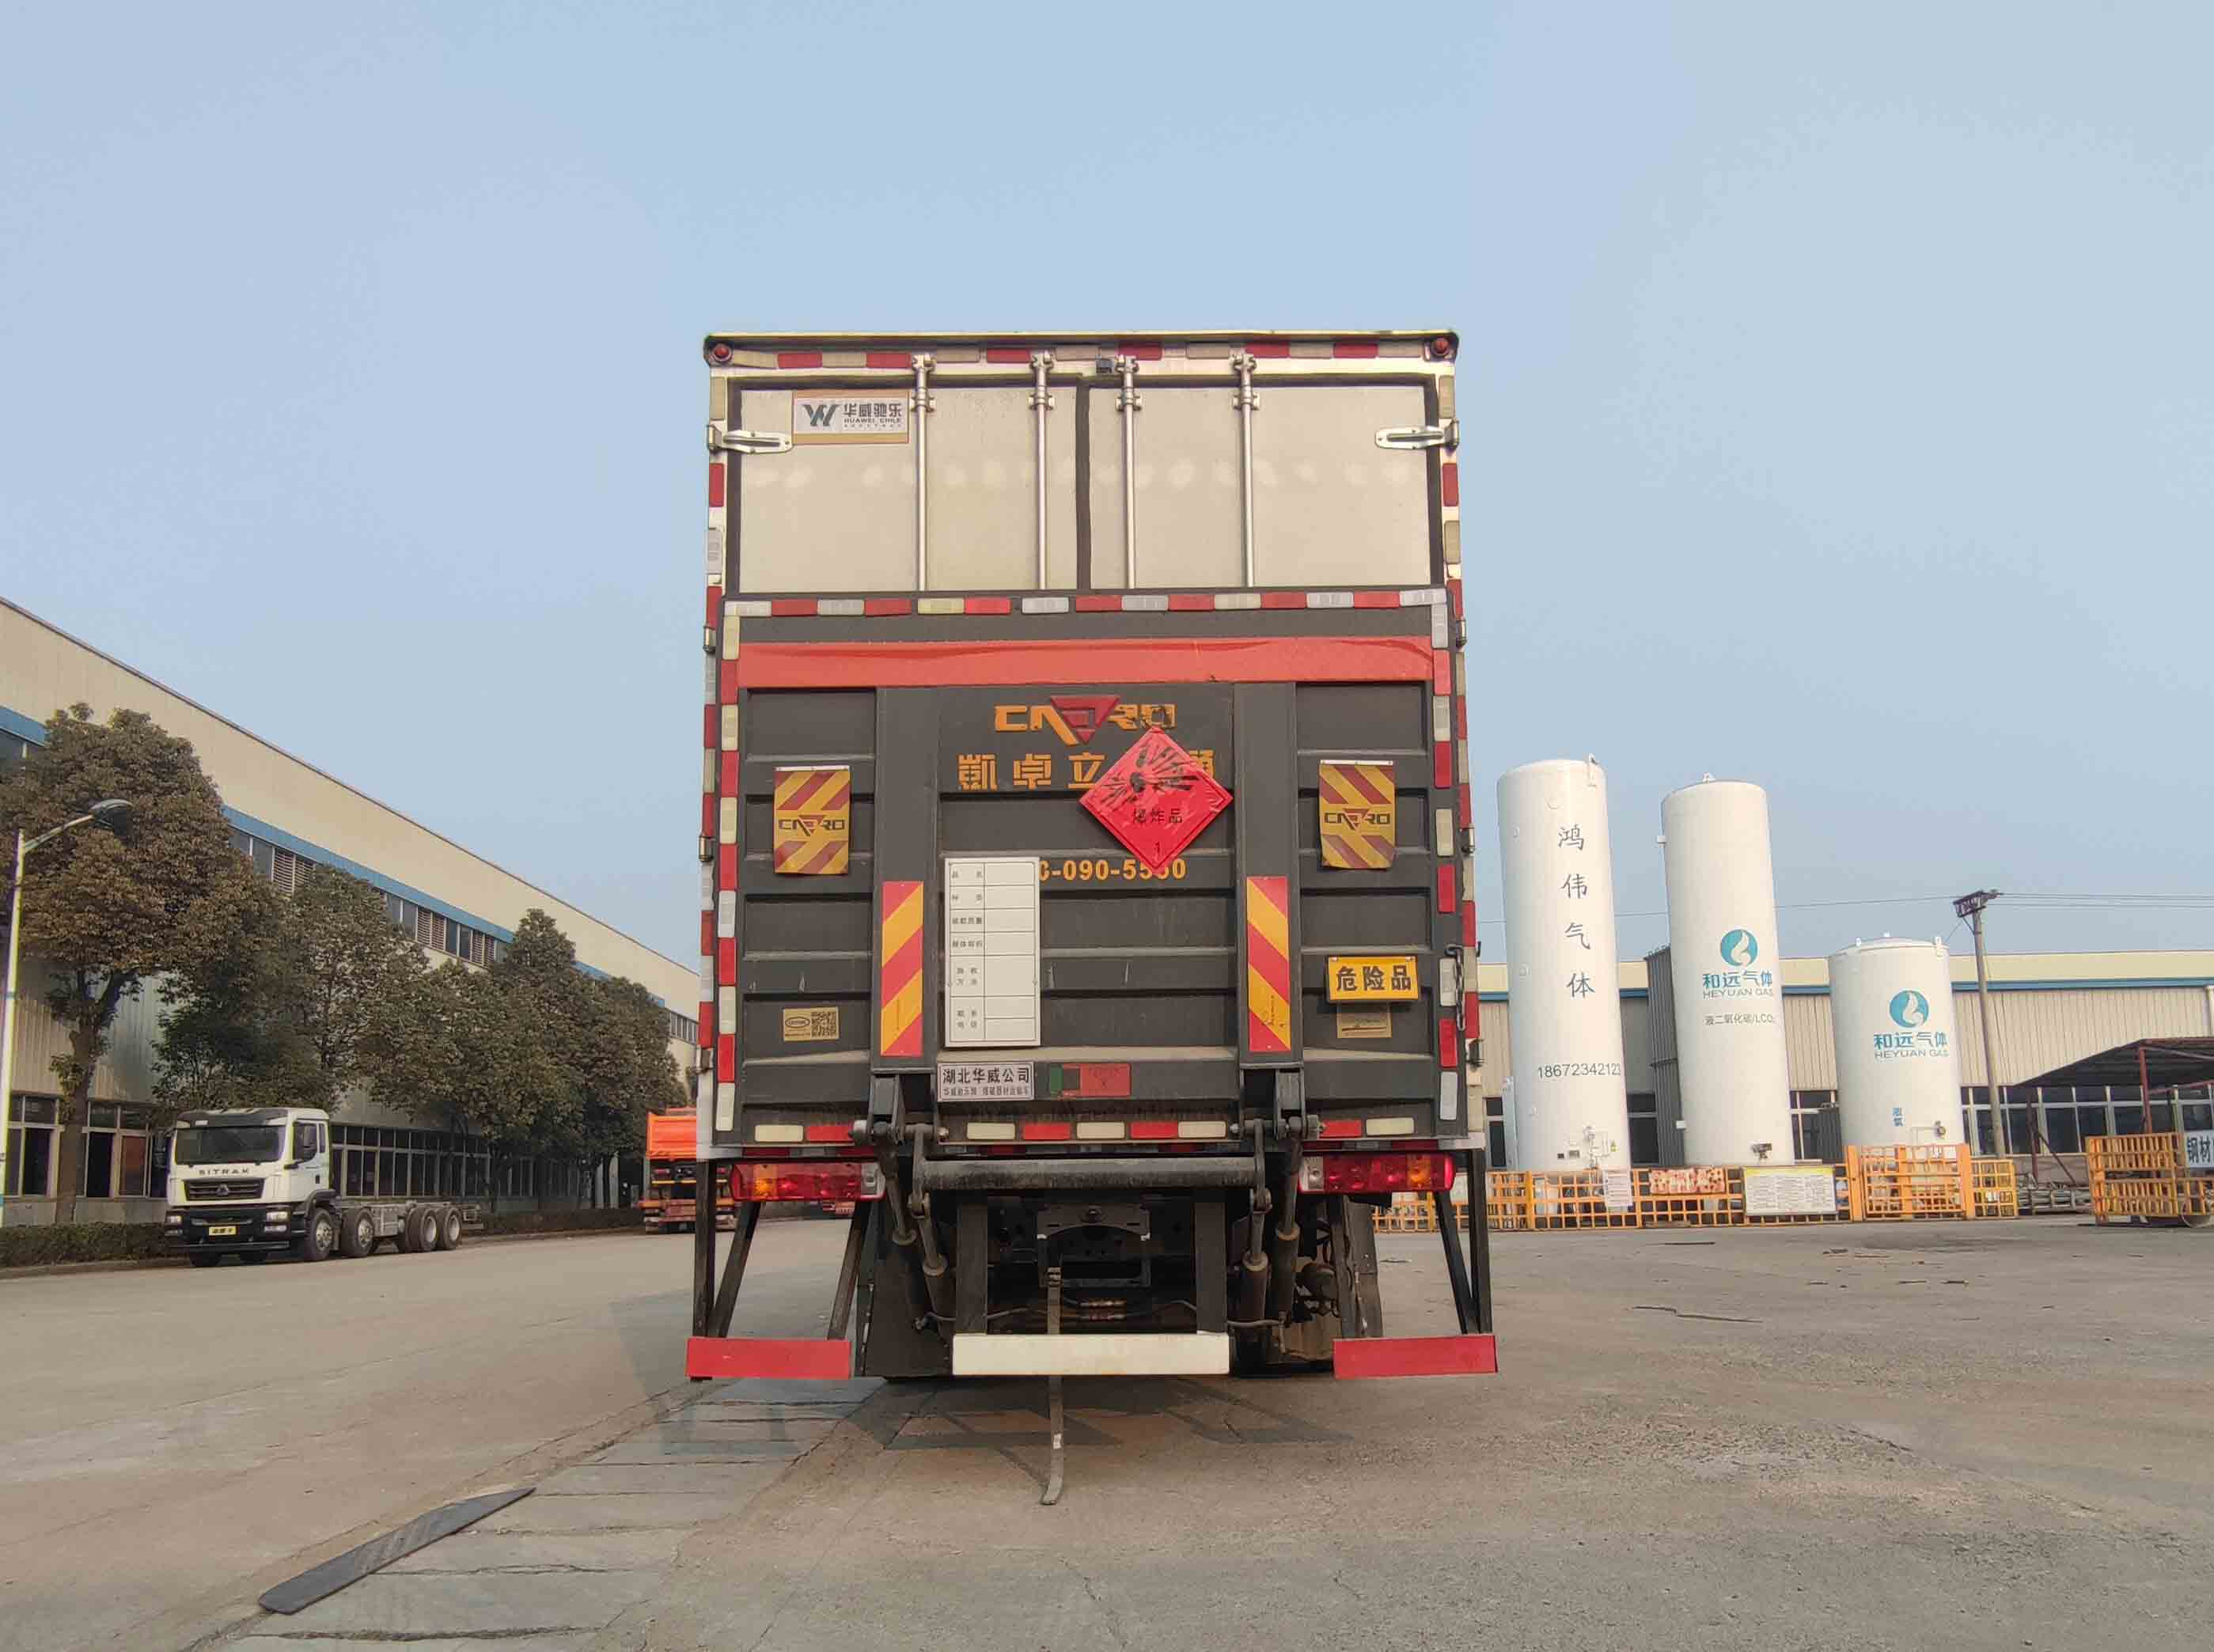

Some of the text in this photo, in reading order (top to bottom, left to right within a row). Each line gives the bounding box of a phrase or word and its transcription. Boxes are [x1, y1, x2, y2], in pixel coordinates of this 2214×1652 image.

[843, 403, 901, 417] 华威驰乐
[1558, 824, 1594, 999] 鸿伟气体
[1336, 965, 1412, 991] 危险品
[1703, 969, 1772, 989] 和远气体
[1703, 988, 1752, 999] HEYUAN
[1874, 1032, 1948, 1049] 和远气体
[1875, 1050, 1926, 1059] HEYUAN
[943, 1067, 1029, 1084] 湖北华威公司
[1538, 1063, 1621, 1079] 18672342123
[2186, 1135, 2214, 1165] 钢材
